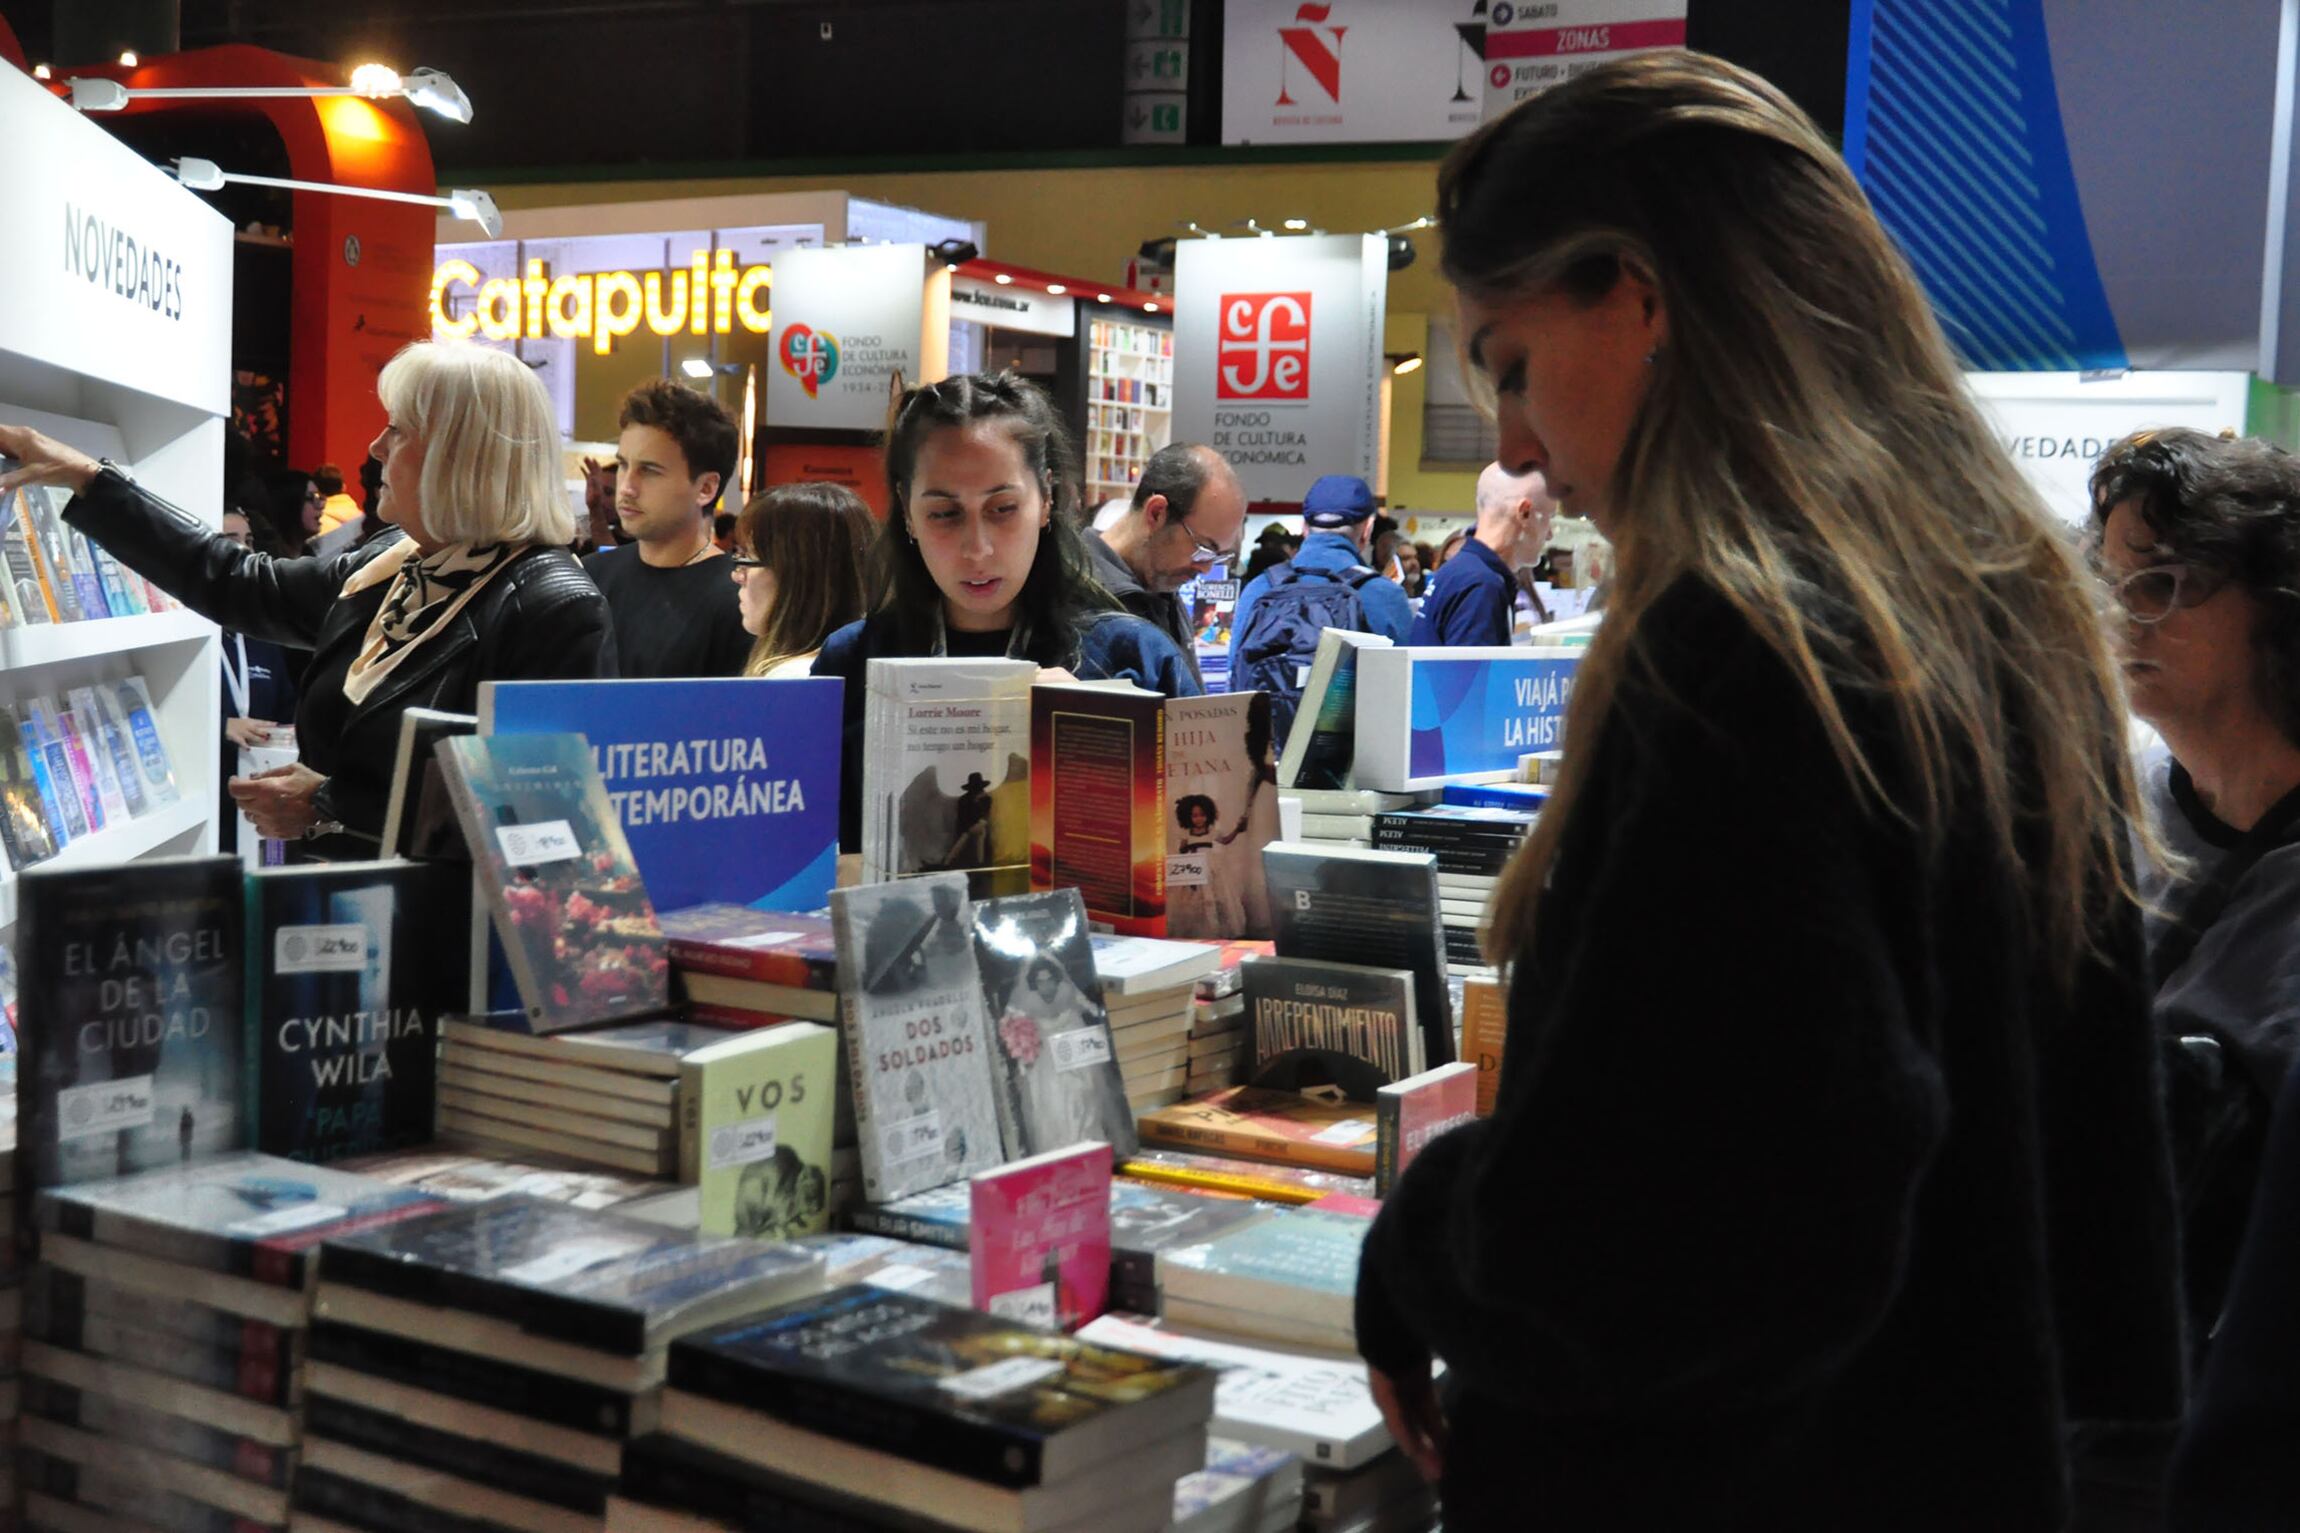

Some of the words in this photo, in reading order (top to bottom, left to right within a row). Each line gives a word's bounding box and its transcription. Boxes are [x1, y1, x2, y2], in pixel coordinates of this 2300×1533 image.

[1556, 27, 1610, 51] ZONAS
[1515, 64, 1557, 82] FUTURO
[65, 201, 181, 321] NOVEDADES
[842, 336, 881, 348] FONDO
[842, 351, 855, 362] DE
[859, 349, 908, 362] CULTURA
[1214, 411, 1271, 428] FONDO
[1213, 431, 1232, 447] DE
[1237, 431, 1307, 447] CULTURA
[1221, 448, 1306, 466] CONÓMICA
[1514, 670, 1559, 713] VIAJÁ
[909, 707, 942, 718] Lorrie
[945, 706, 982, 718] Moore
[1179, 706, 1237, 722] POSADAS
[1173, 730, 1217, 747] HIJA
[1504, 717, 1524, 747] LA
[1526, 715, 1563, 745] HIST
[591, 736, 768, 780] LITERATURA
[1168, 759, 1232, 778] ETANA
[608, 775, 806, 826] TEMPORÁNEA
[1295, 890, 1312, 911] B
[65, 943, 97, 977] EL
[110, 929, 224, 971] ÁNGEL
[101, 975, 141, 1012] DE
[155, 972, 192, 1005] LA
[79, 1006, 211, 1054] CIUDAD
[278, 1008, 424, 1053] CYNTHIA
[905, 1015, 943, 1040] DOS
[1256, 996, 1400, 1084] ARREPENTIMIENTO
[879, 1035, 974, 1072] SOLDADOS
[1479, 1053, 1496, 1072] D
[311, 1051, 393, 1088] WILA
[737, 1074, 806, 1113] VOS
